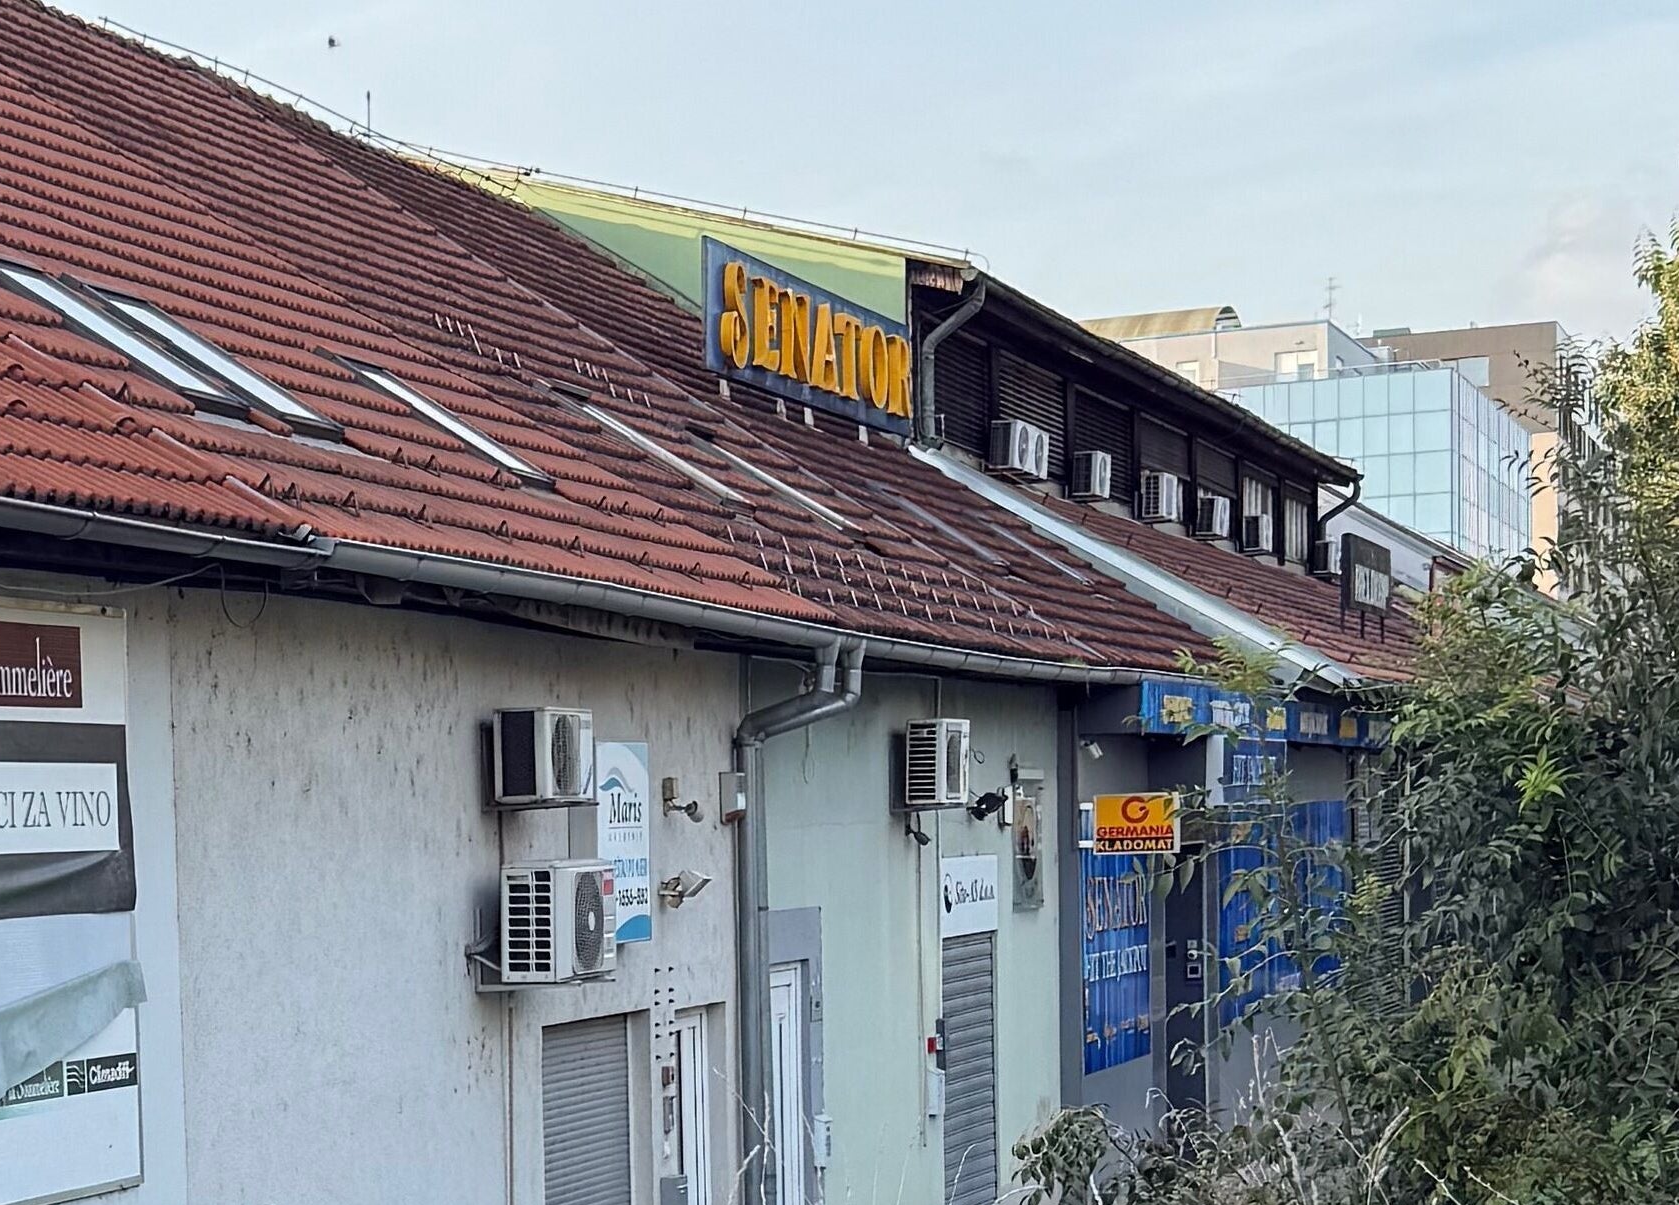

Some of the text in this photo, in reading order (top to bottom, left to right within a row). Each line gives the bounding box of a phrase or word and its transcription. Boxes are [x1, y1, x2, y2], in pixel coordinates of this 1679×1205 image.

[720, 260, 913, 419] SENATOR
[22, 790, 50, 829] ZA
[55, 790, 112, 828] VINO
[609, 792, 642, 824] Maris
[1096, 824, 1174, 838] GERMANIA
[1096, 838, 1173, 851] KLADOMAT
